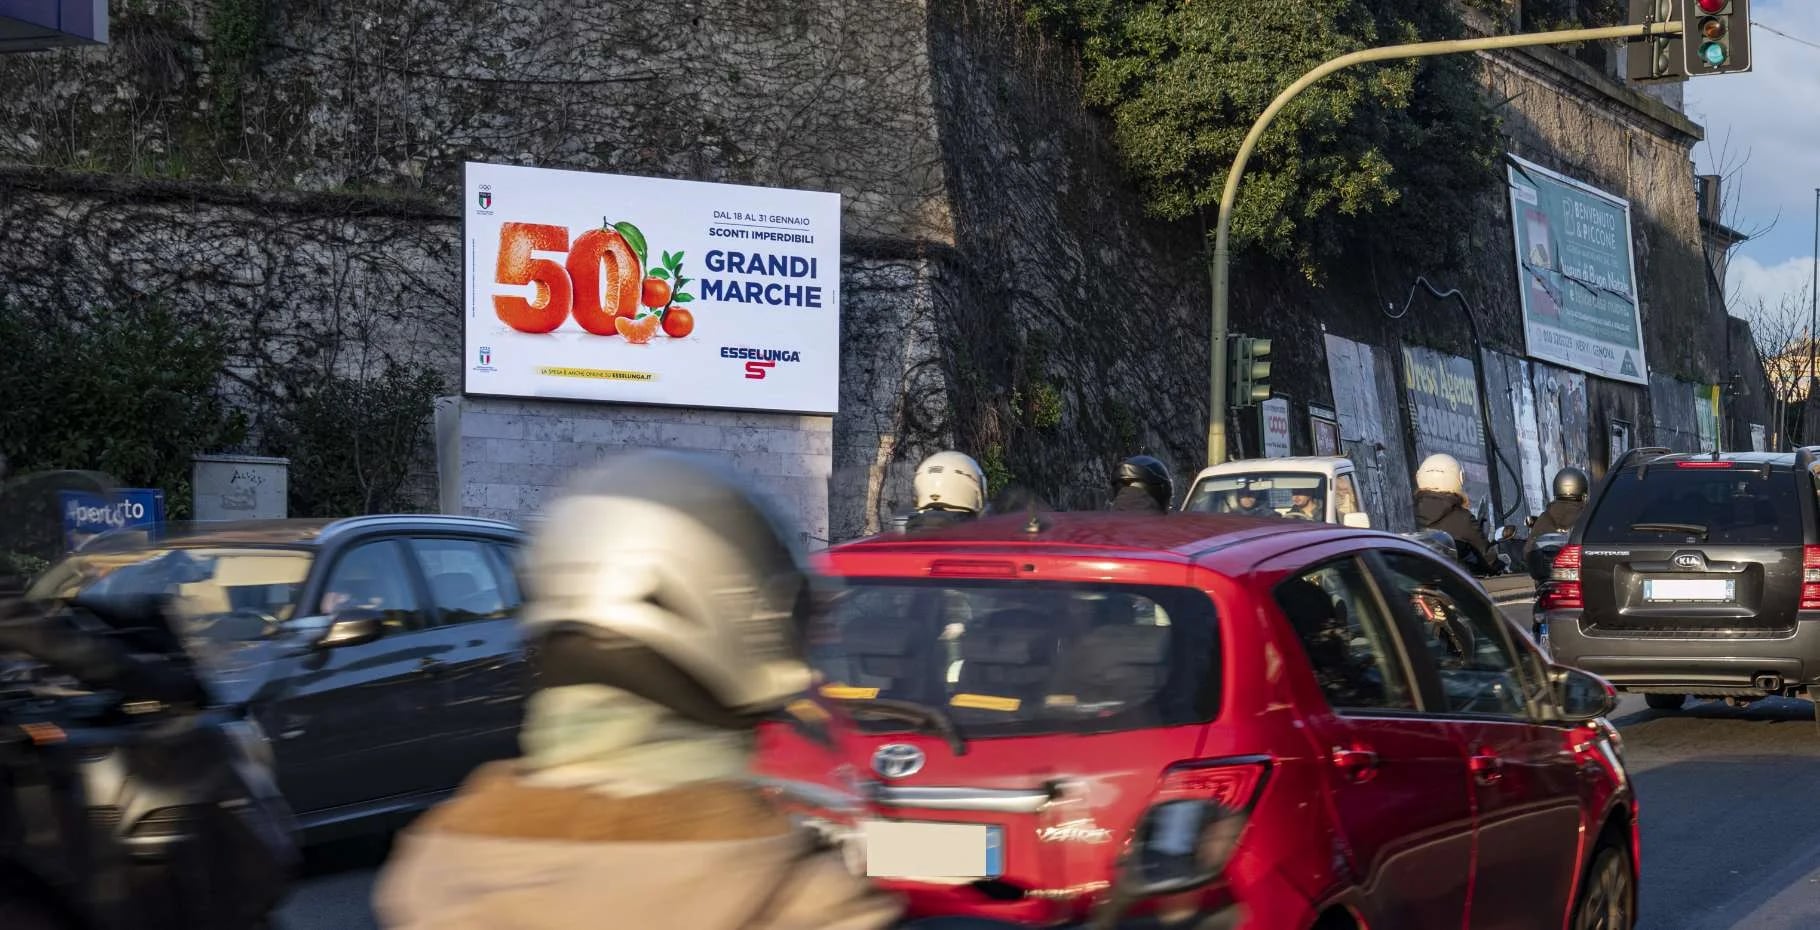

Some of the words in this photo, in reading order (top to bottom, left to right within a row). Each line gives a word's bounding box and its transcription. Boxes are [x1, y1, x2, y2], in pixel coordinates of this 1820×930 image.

[713, 210, 732, 220] DAL
[733, 212, 743, 220] 18
[744, 213, 757, 222] AL
[758, 214, 767, 222] 31
[769, 215, 810, 226] GENNAIO
[1574, 201, 1615, 231] BENVENUTO
[708, 227, 749, 239] SCONTI
[751, 231, 814, 244] IMPERDIBILI
[1576, 221, 1582, 238] &
[1583, 223, 1616, 250] PICCONE
[492, 221, 642, 336] 50
[705, 249, 817, 279] GRANDI
[700, 278, 822, 309] MARCHE
[720, 346, 800, 363] ESSELUNGA
[1401, 346, 1438, 396] Dress
[1439, 360, 1478, 415] Agency
[1418, 404, 1479, 446] COMPRO
[1679, 557, 1699, 566] KIA
